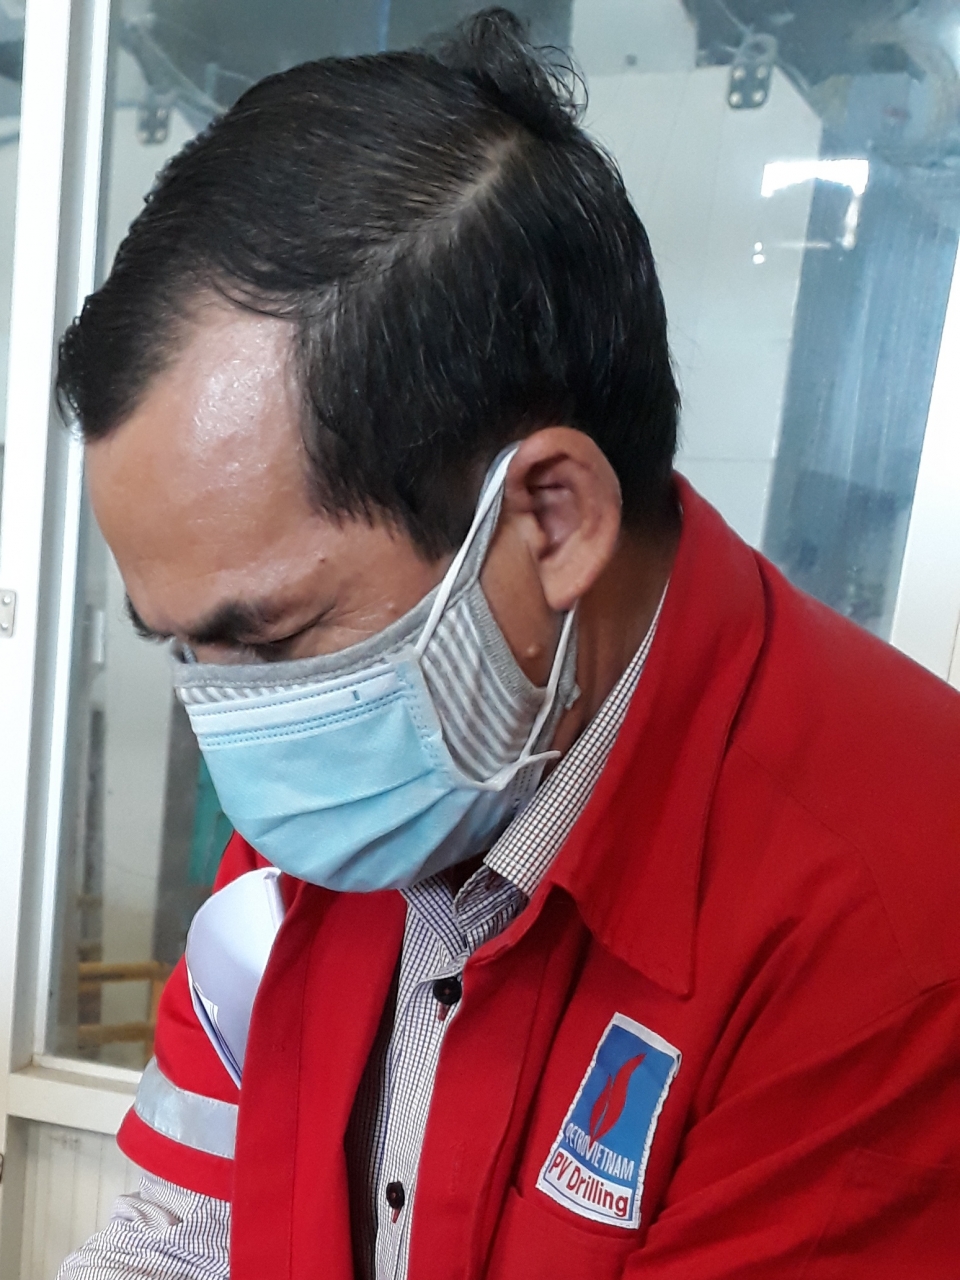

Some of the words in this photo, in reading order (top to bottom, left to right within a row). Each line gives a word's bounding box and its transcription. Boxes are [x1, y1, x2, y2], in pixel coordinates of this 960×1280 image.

[565, 1122, 635, 1181] PETROVIETNAM
[548, 1150, 573, 1181] PV
[566, 1166, 629, 1217] Drilling
